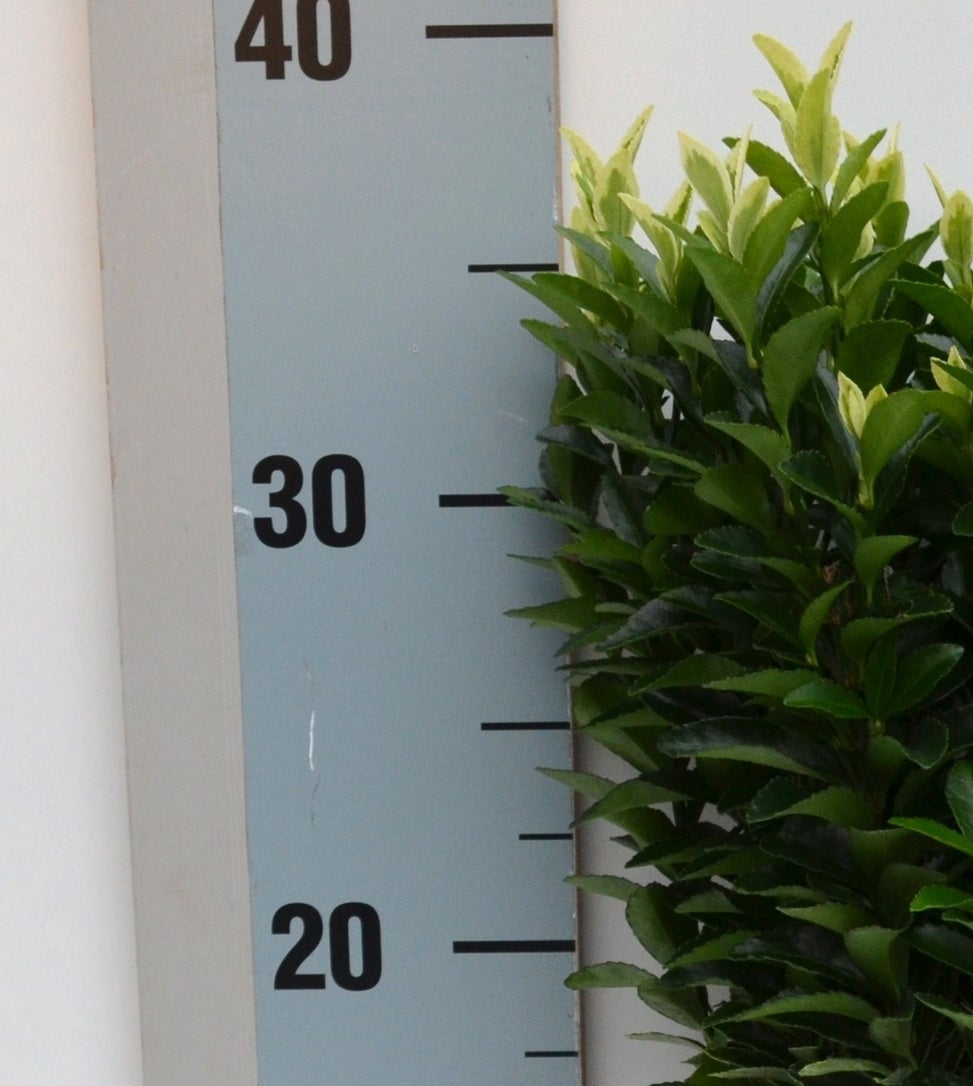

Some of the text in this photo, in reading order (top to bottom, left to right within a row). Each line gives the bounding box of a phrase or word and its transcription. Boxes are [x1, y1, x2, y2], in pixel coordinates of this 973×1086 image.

[234, 0, 352, 82] 40
[253, 454, 367, 548] 30
[272, 902, 383, 991] 20
